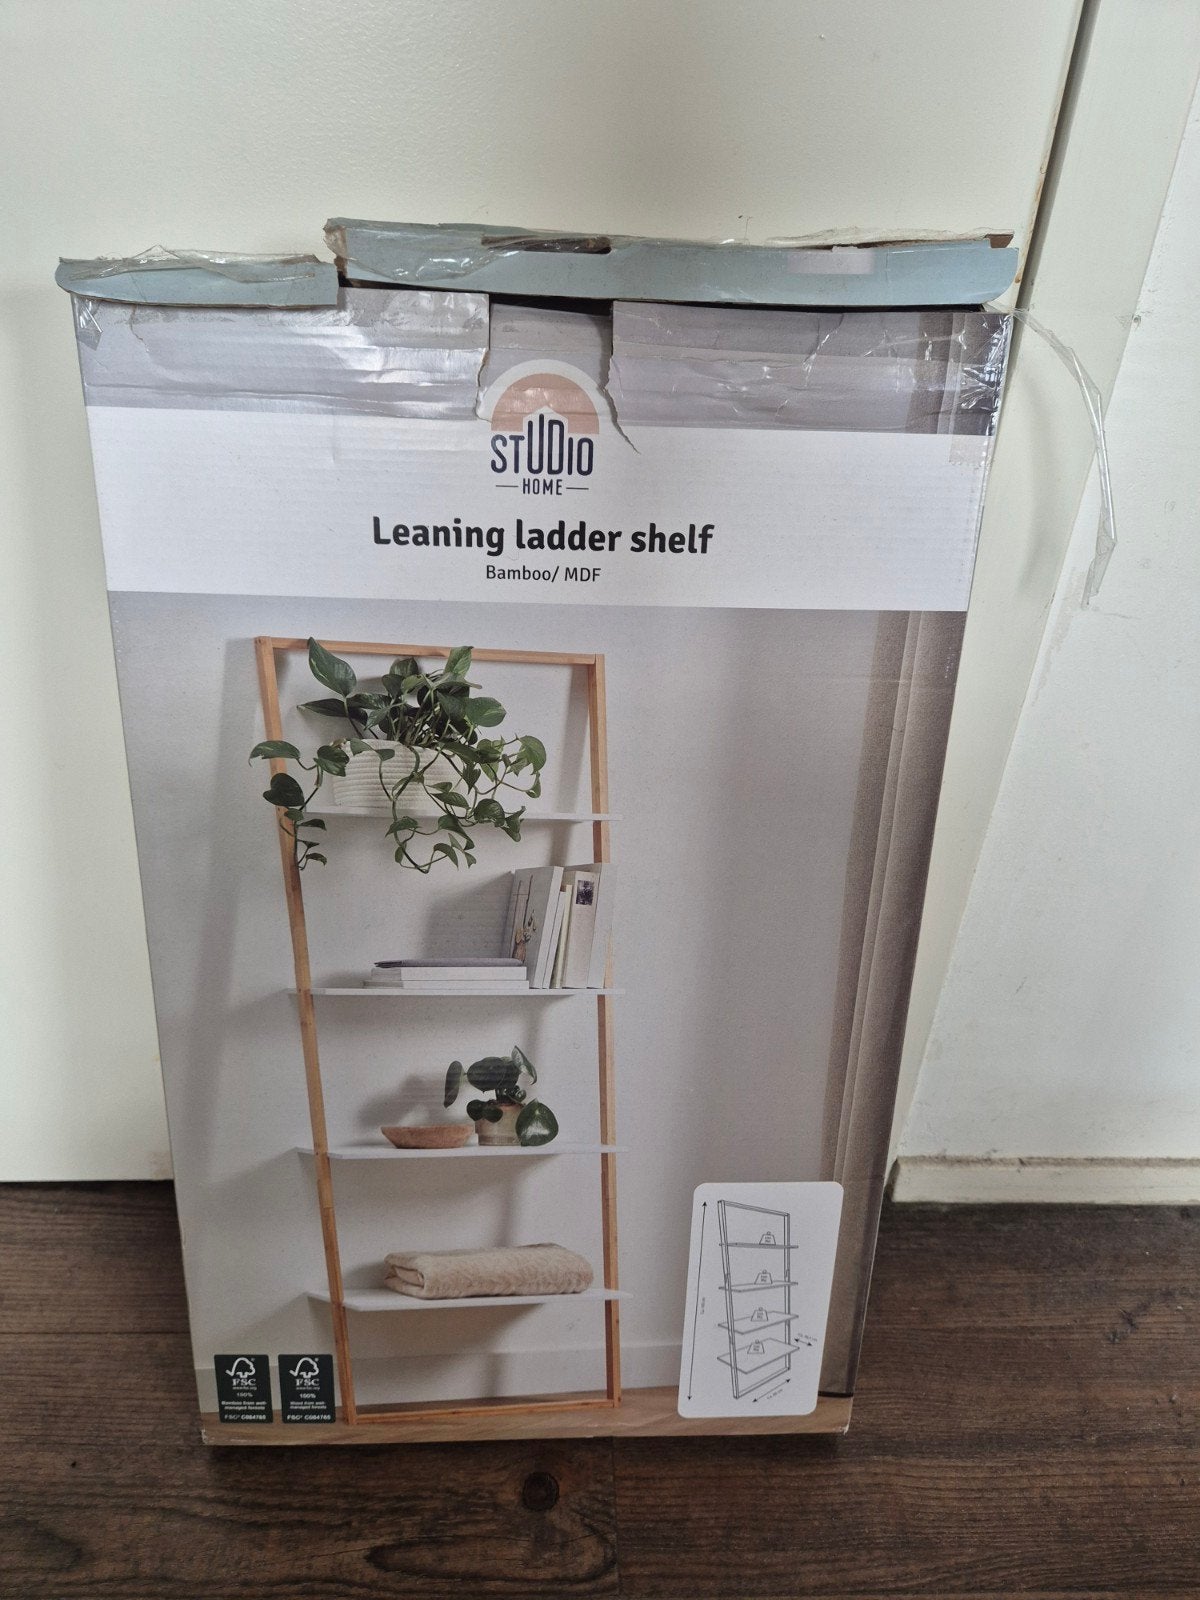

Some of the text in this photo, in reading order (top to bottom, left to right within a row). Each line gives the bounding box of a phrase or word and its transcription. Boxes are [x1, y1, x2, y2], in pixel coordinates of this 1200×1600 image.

[490, 413, 594, 477] STUDIO
[522, 478, 563, 496] HOME
[372, 515, 716, 557] Leaning ladder shelf
[485, 564, 602, 584] Bamboo/ MDF
[232, 1378, 257, 1386] FSC
[295, 1378, 320, 1386] FSC
